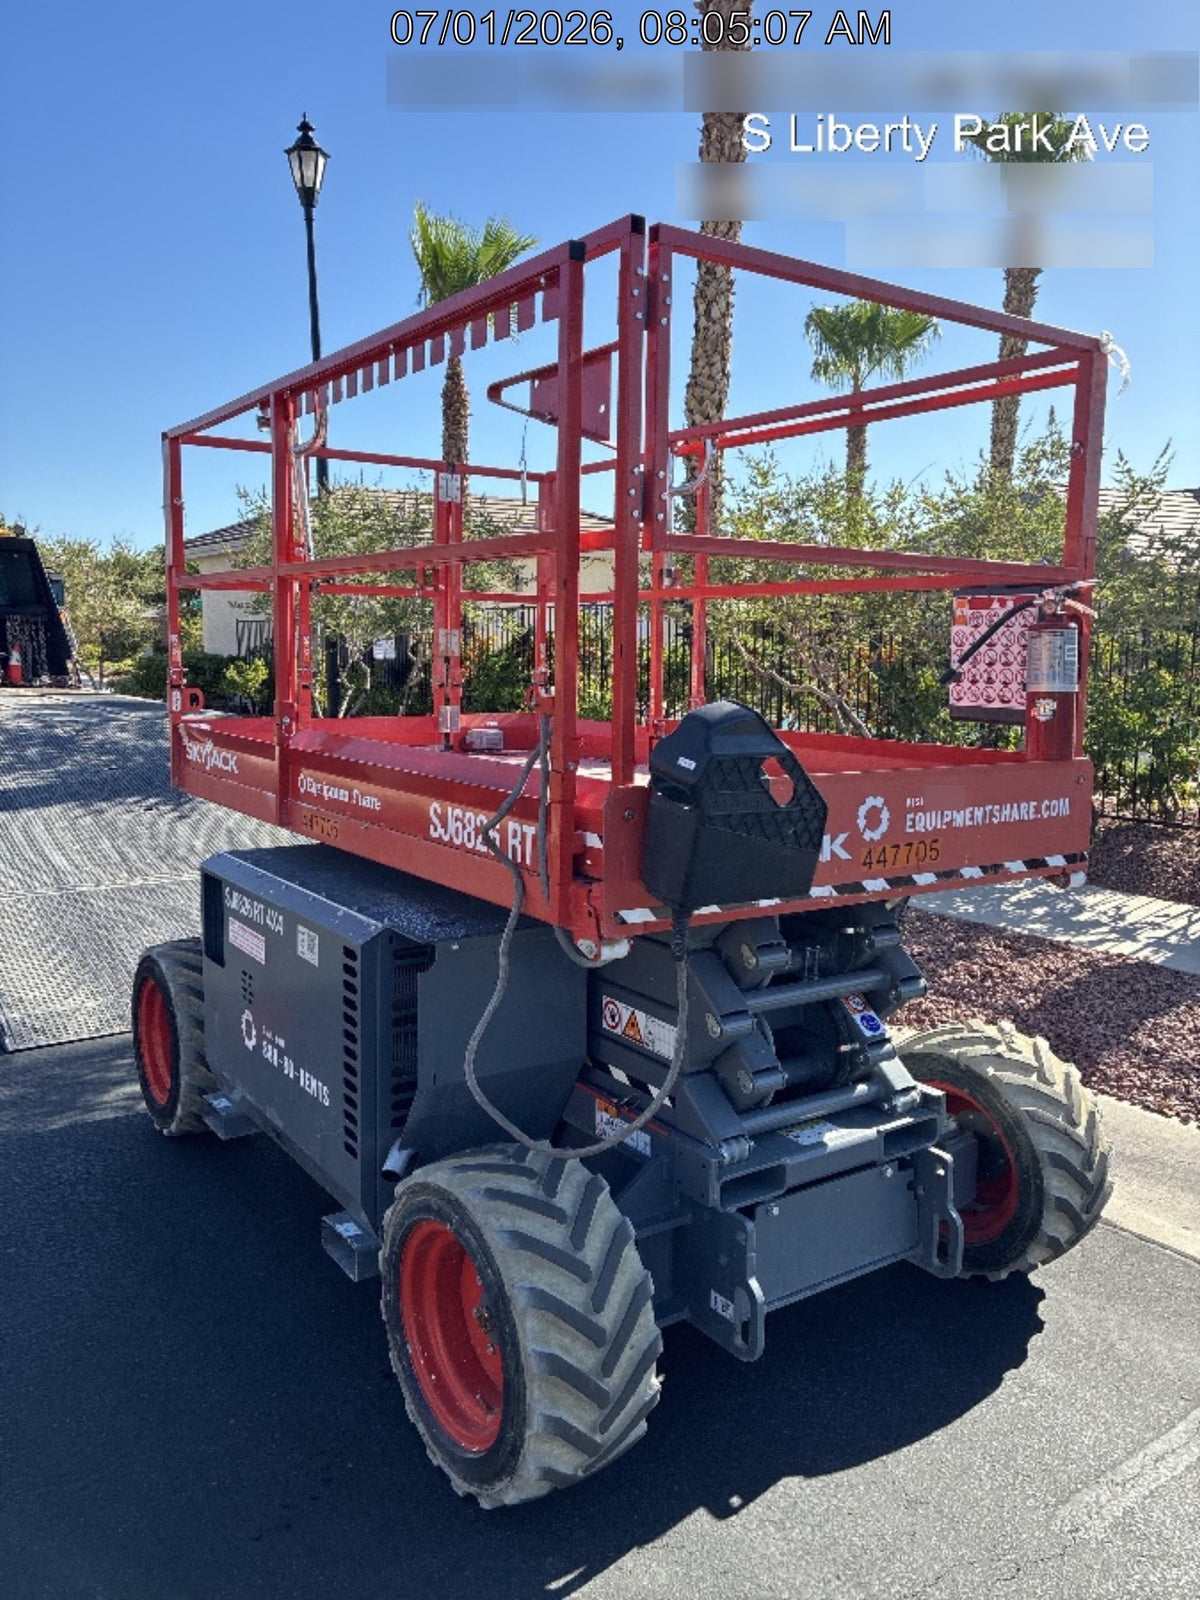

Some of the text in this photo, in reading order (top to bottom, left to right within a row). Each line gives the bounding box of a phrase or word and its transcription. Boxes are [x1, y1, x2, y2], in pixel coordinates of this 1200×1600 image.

[904, 798, 1070, 833] EQUIPMENTSHARE.COM
[508, 820, 536, 866] RT
[862, 839, 940, 870] 447705
